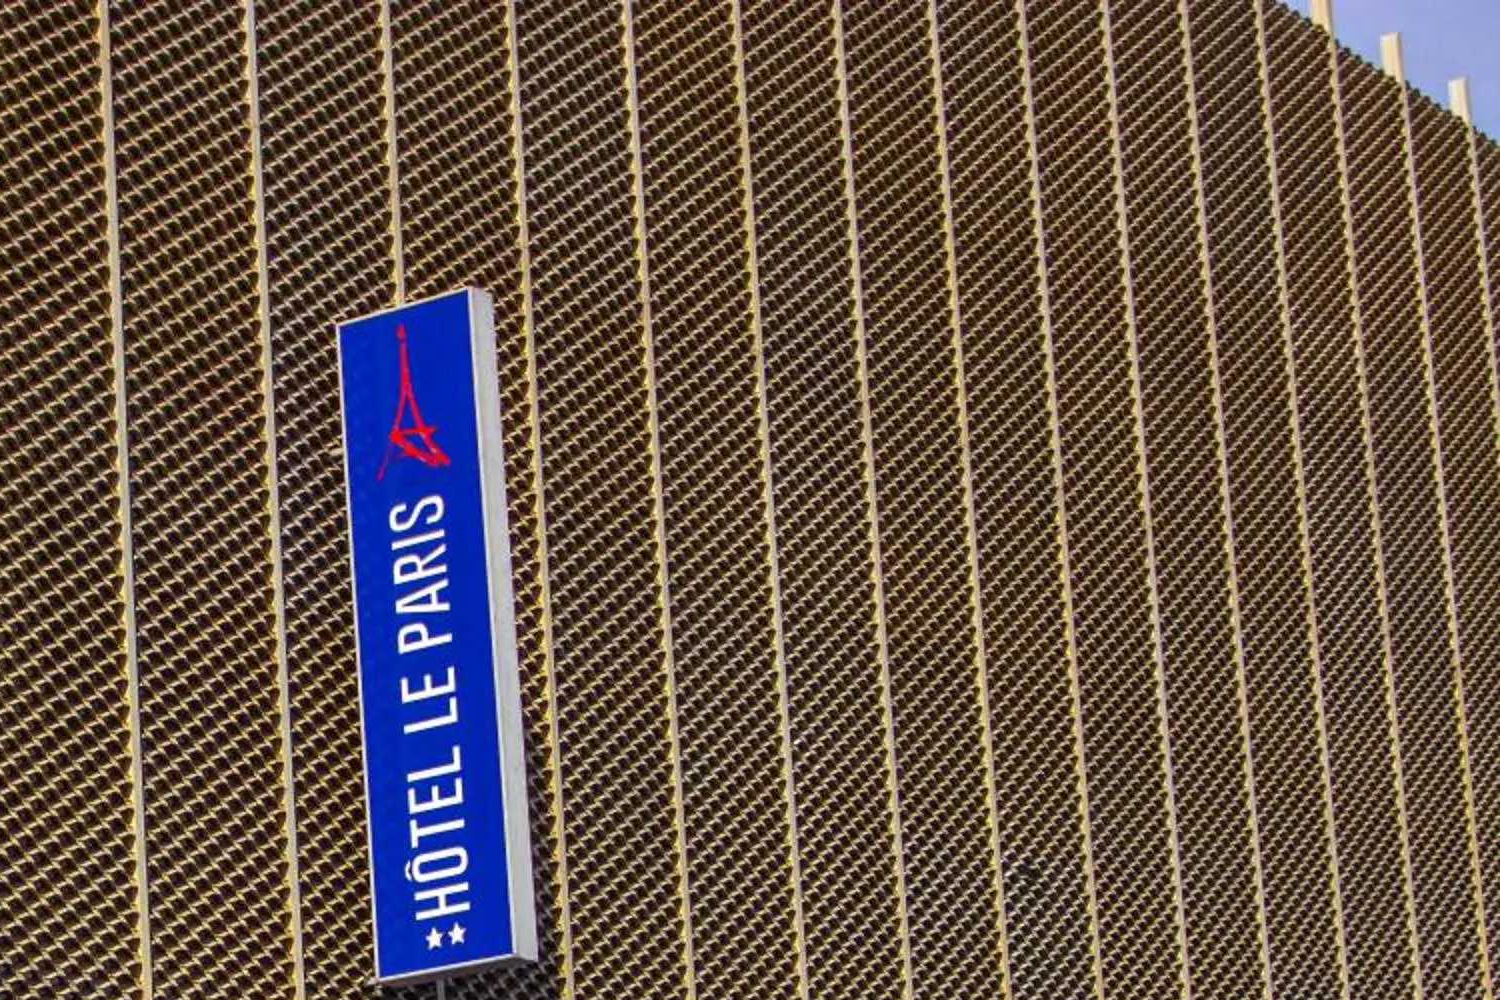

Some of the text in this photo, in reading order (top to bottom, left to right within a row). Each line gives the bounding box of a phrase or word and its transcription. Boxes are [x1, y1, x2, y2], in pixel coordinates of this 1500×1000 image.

[389, 493, 471, 921] HÔTEL LE PARIS
